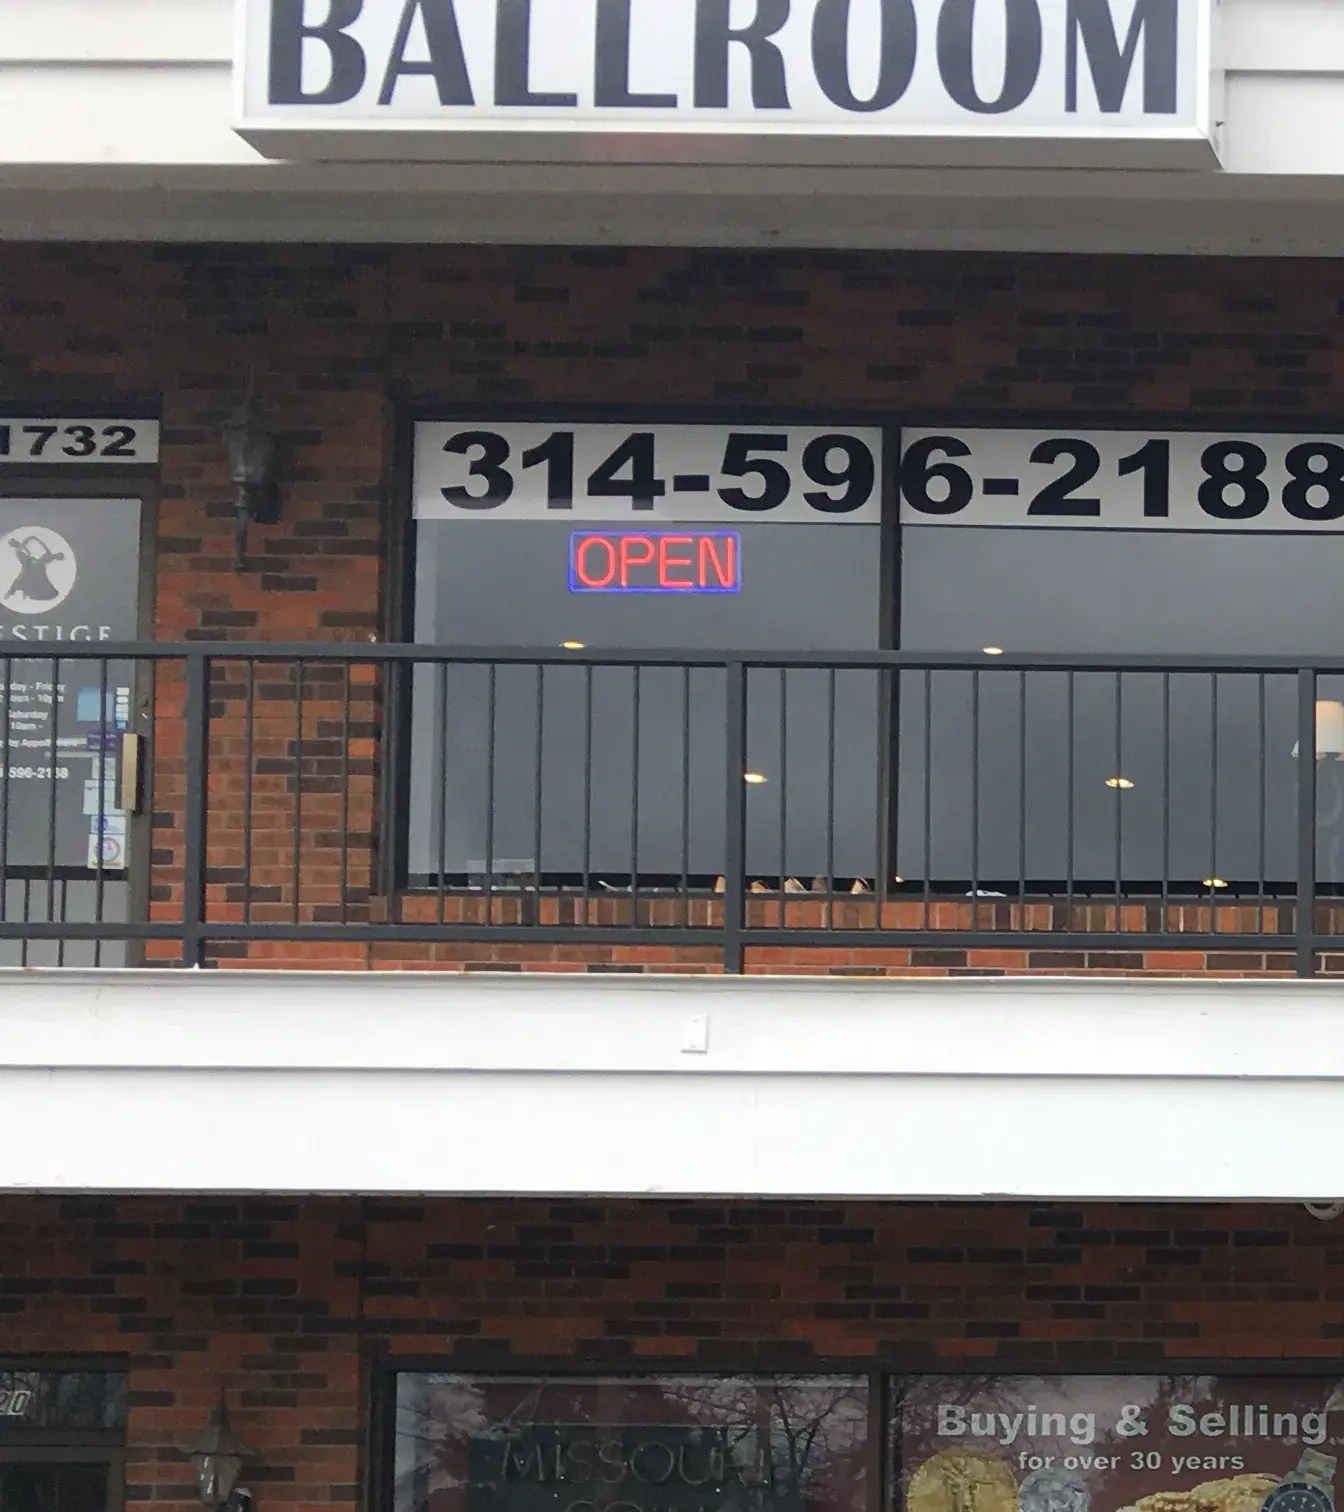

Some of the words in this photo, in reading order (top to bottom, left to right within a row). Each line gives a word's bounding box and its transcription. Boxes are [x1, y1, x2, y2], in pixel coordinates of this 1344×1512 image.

[266, 0, 1179, 114] BALLROOM
[575, 536, 737, 588] OPEN
[0, 624, 112, 641] STIGE
[937, 1404, 1097, 1445] Buying
[1115, 1405, 1149, 1437] &
[1168, 1403, 1328, 1445] Selling
[1018, 1451, 1057, 1470] for
[1063, 1455, 1121, 1470] over
[1130, 1451, 1162, 1470] 30
[1171, 1454, 1245, 1473] years
